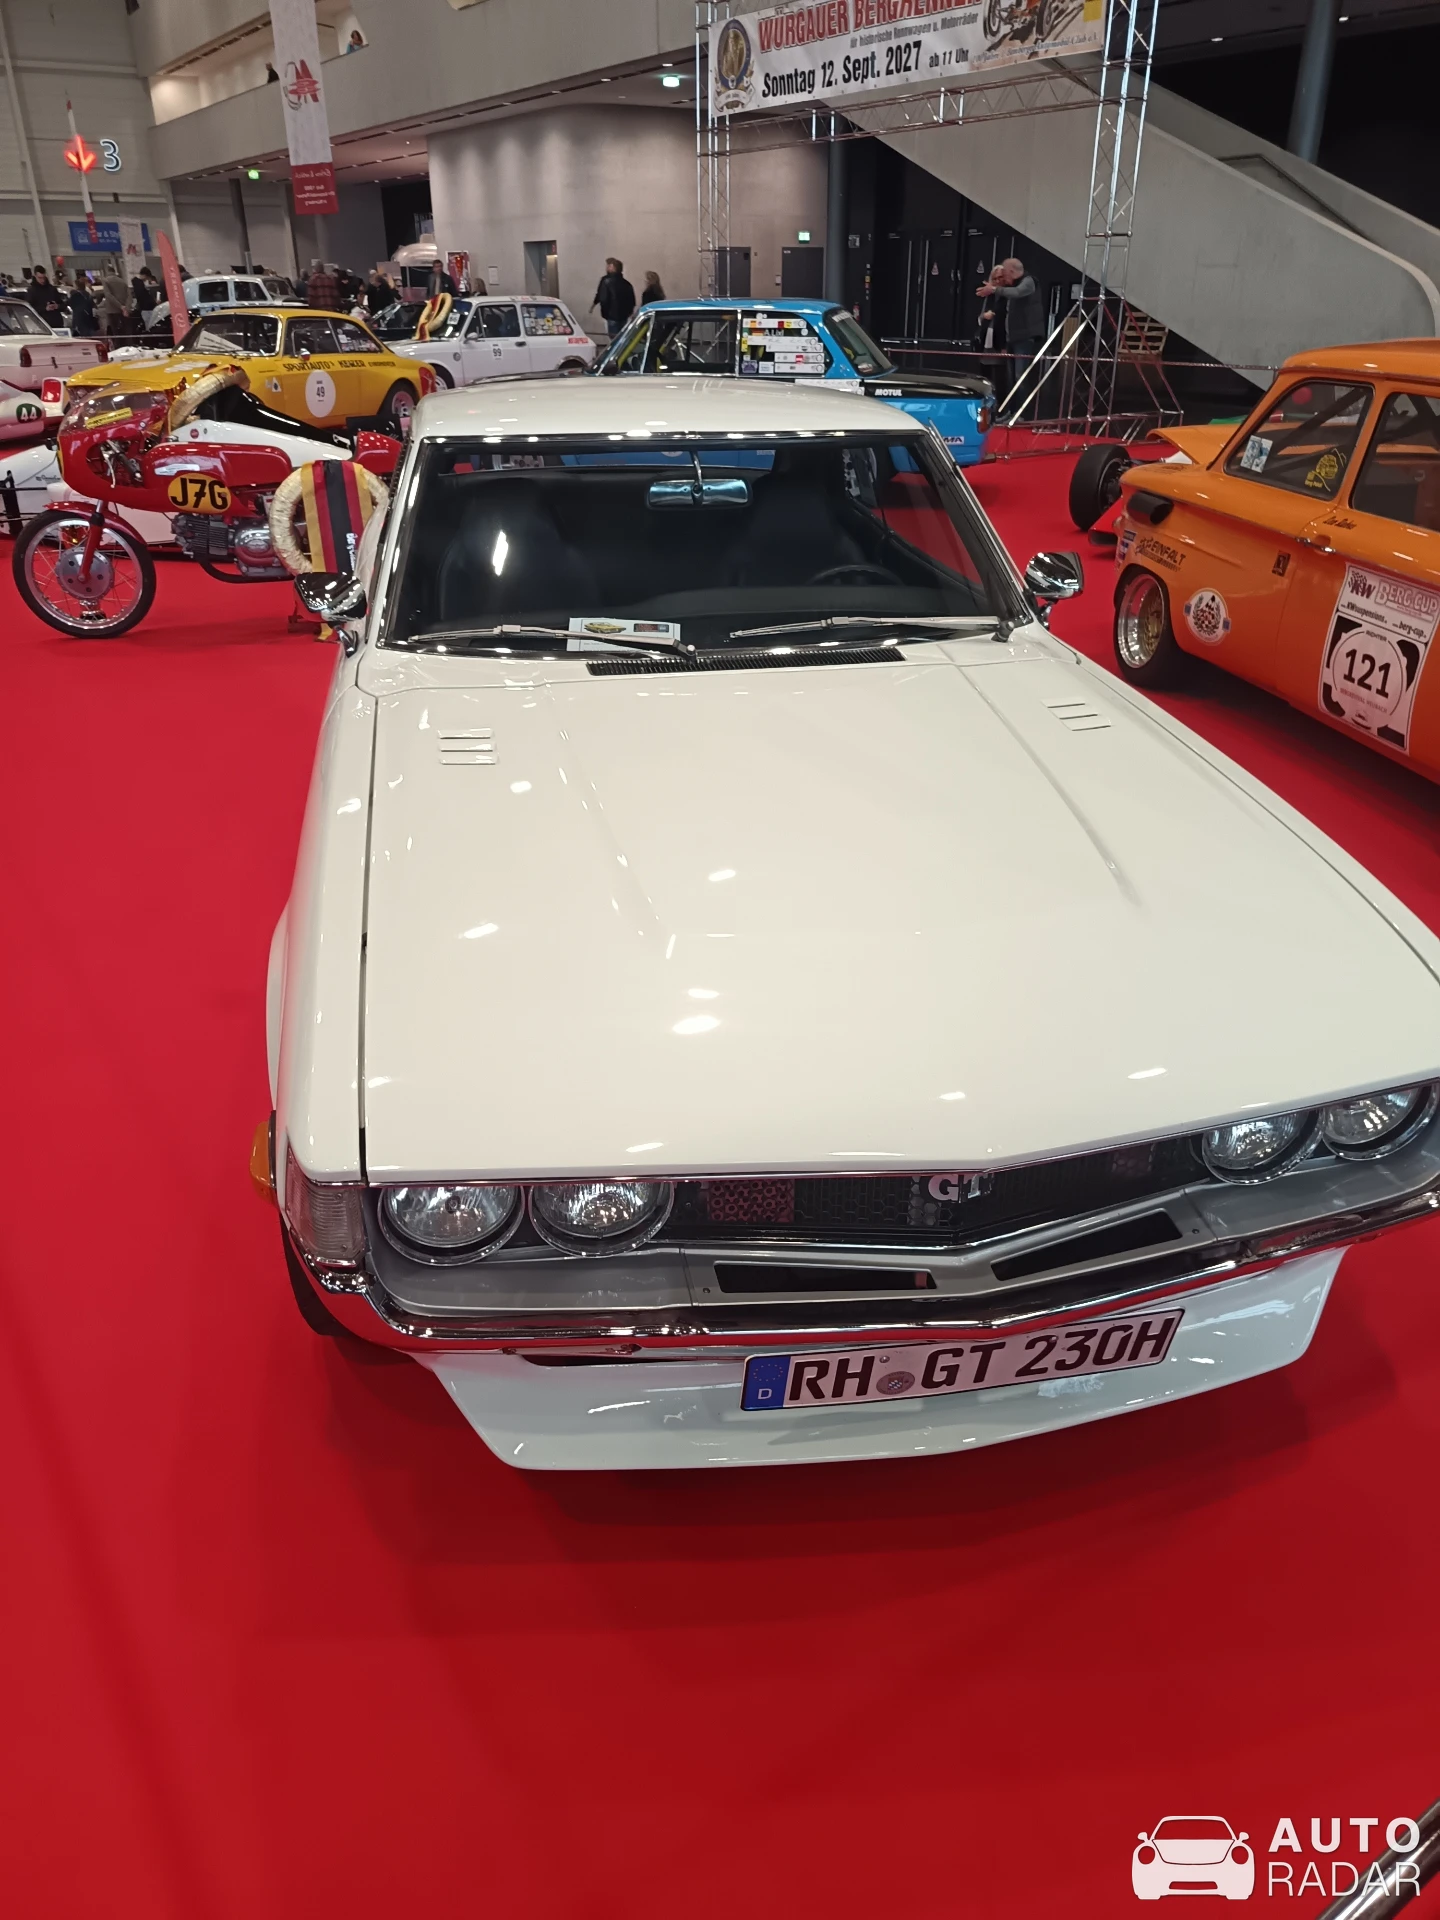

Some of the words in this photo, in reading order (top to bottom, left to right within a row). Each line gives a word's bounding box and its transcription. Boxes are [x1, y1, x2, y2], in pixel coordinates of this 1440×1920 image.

[757, 0, 850, 54] WÜRGAUER
[859, 29, 892, 46] historische
[893, 23, 931, 40] Rennwagen
[941, 12, 979, 30] Motorräder
[762, 68, 816, 98] Sonntag
[821, 60, 838, 88] 12.
[842, 51, 880, 84] Sept.
[885, 40, 922, 76] 2027
[929, 52, 940, 68] ab
[942, 50, 953, 66] 11
[955, 48, 969, 63] Uhr
[100, 139, 121, 171] 3
[493, 348, 502, 357] 99
[316, 386, 325, 398] 49
[874, 388, 903, 397] MOTUL
[20, 406, 38, 421] 44
[1150, 541, 1187, 566] EINFALT
[1350, 579, 1376, 599] KW
[1413, 590, 1439, 614] CUP
[1343, 648, 1391, 699] 121
[928, 1173, 988, 1203] GT
[788, 1355, 875, 1400] RH
[920, 1342, 1004, 1390] GT
[1014, 1317, 1177, 1378] 230H
[757, 1388, 772, 1400] D
